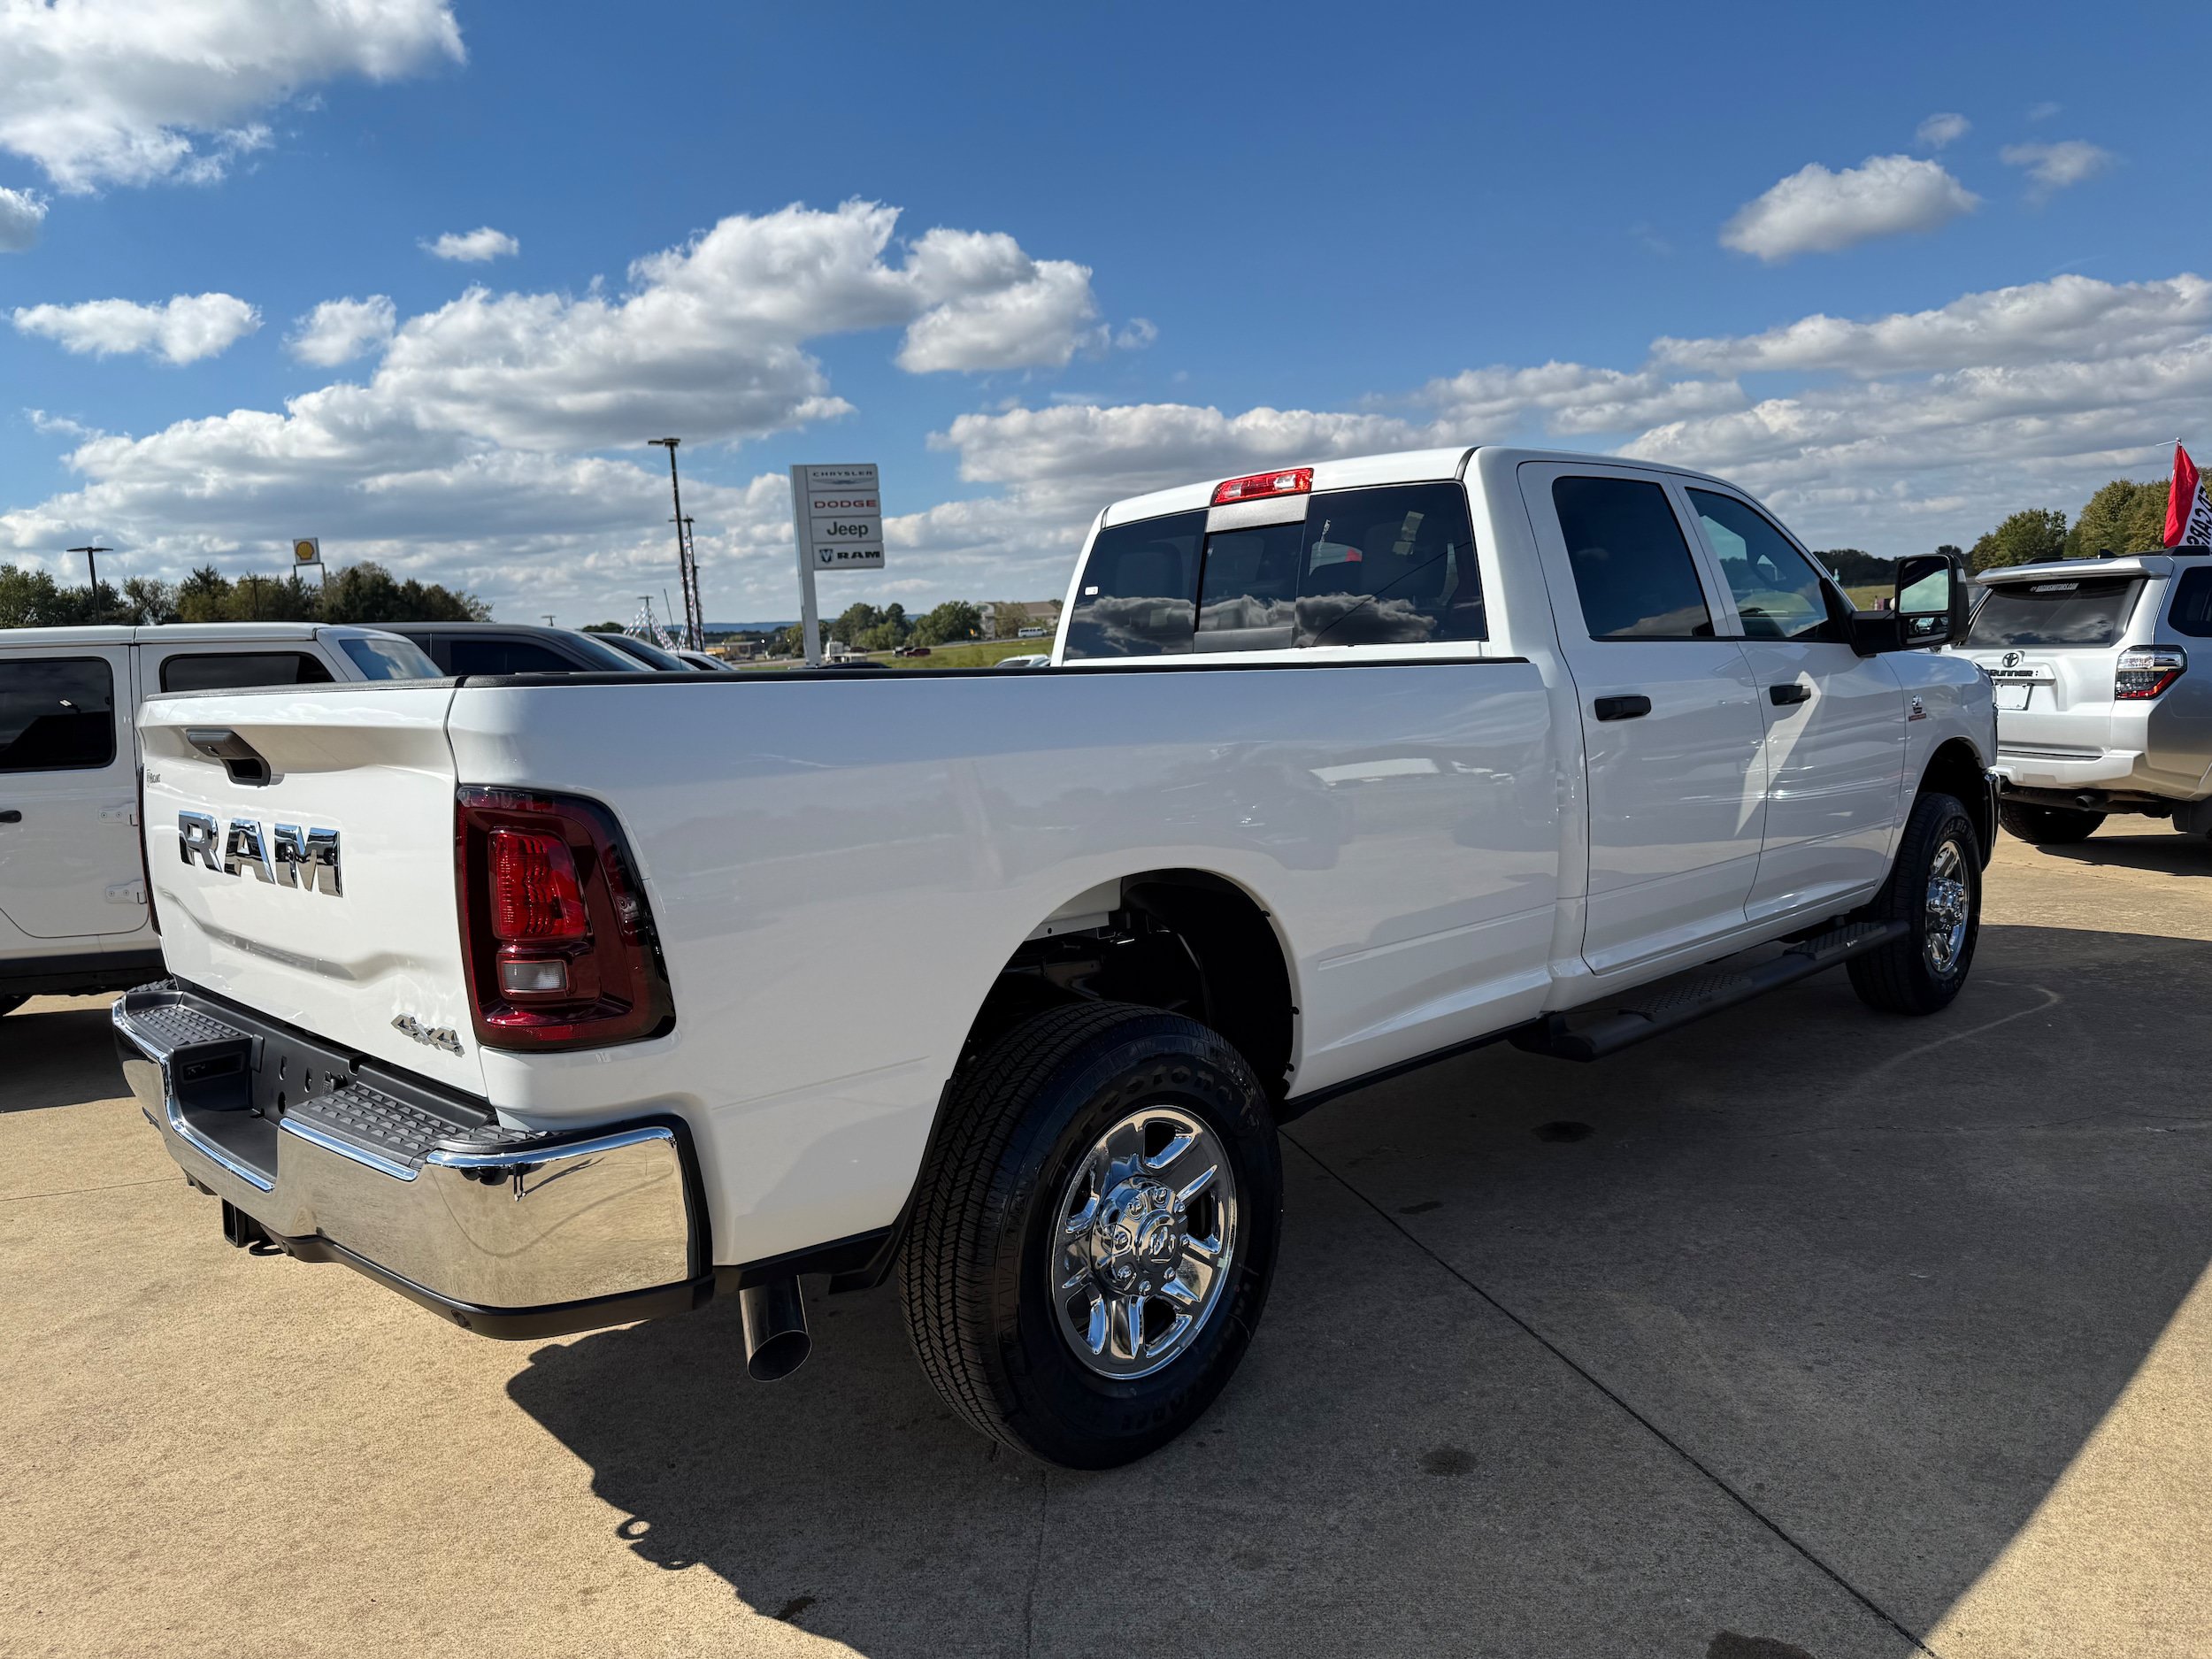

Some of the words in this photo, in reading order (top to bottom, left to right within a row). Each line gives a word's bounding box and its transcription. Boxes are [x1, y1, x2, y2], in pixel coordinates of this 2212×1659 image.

[814, 500, 877, 509] DODGE
[827, 522, 869, 538] Jeep
[178, 810, 343, 898] RAM
